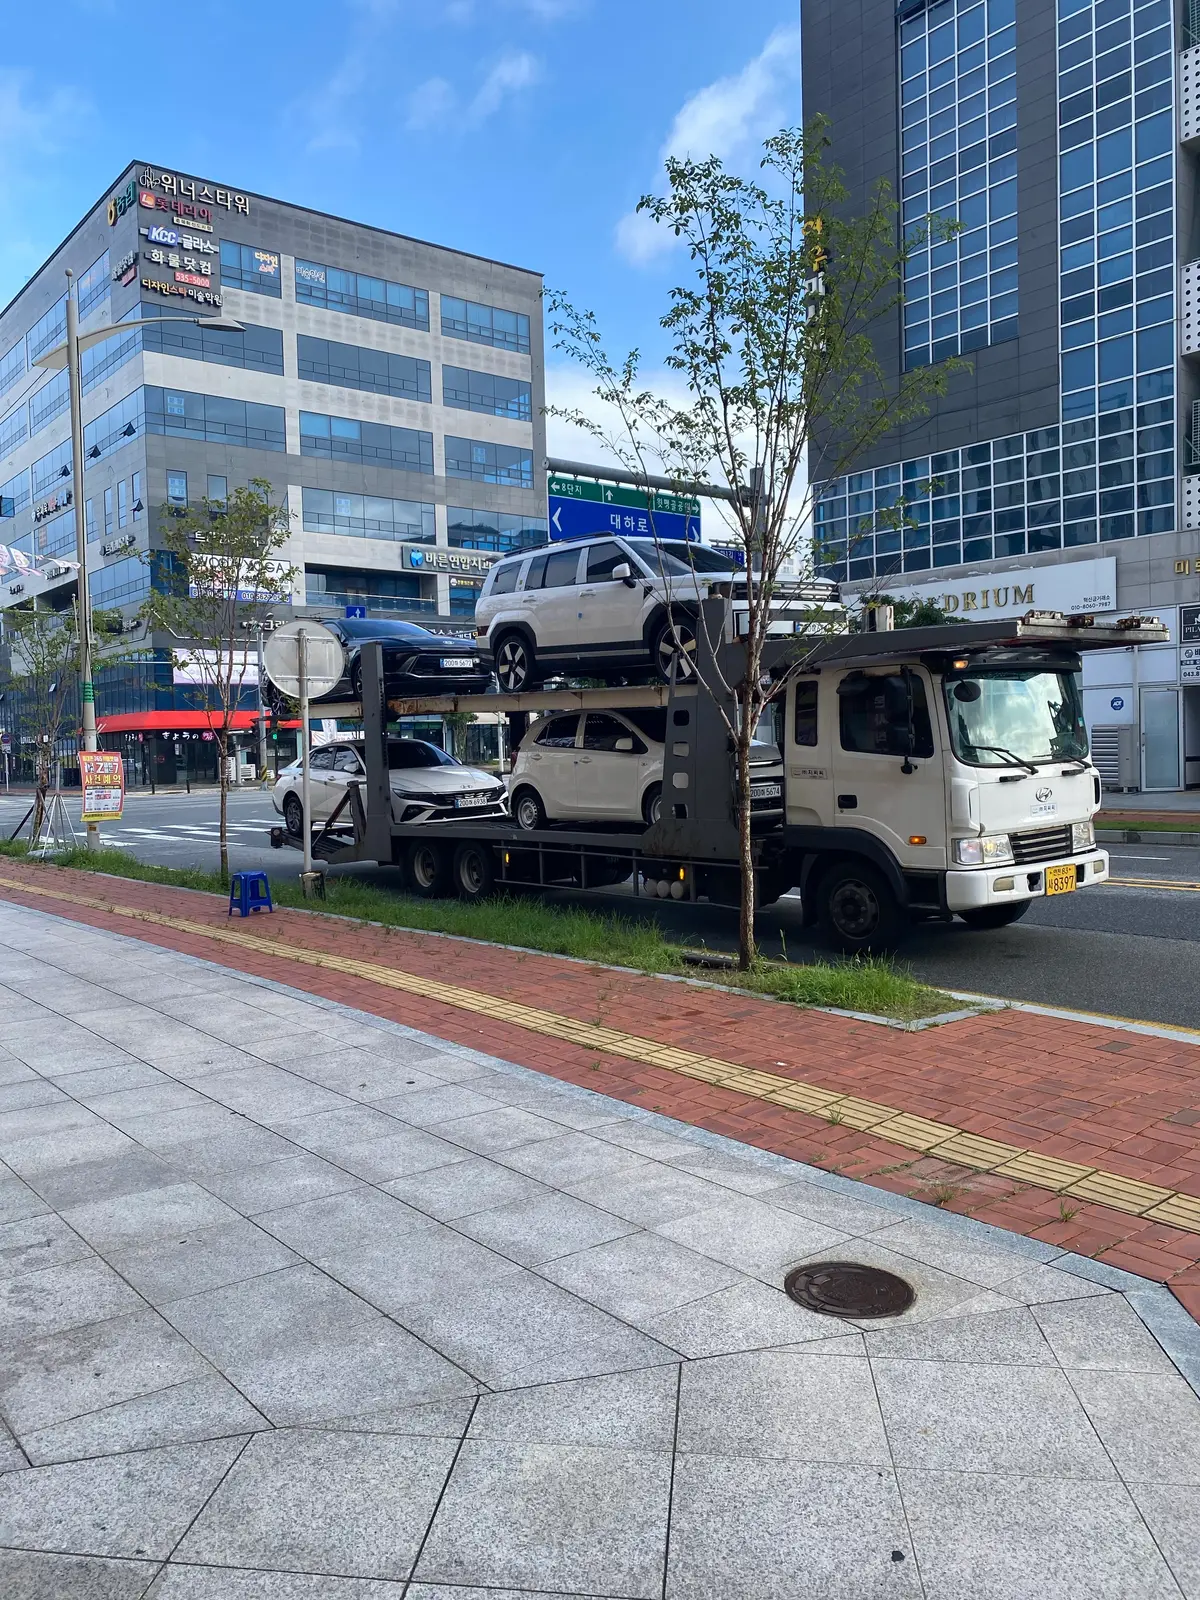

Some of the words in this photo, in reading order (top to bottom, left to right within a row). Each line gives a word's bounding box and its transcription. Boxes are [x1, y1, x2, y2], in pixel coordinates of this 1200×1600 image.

[161, 174, 249, 215] 위너스타워
[156, 197, 213, 222] 롯데리아
[151, 227, 177, 244] KCC
[182, 234, 215, 254] 글라스
[150, 249, 212, 275] 화물닷컴
[176, 273, 210, 287] 535-5000
[188, 288, 223, 306] 미술학원
[561, 482, 582, 495] 8단지
[610, 514, 649, 533] 대하로
[162, 731, 199, 741] きょうの
[766, 786, 780, 796] 5674
